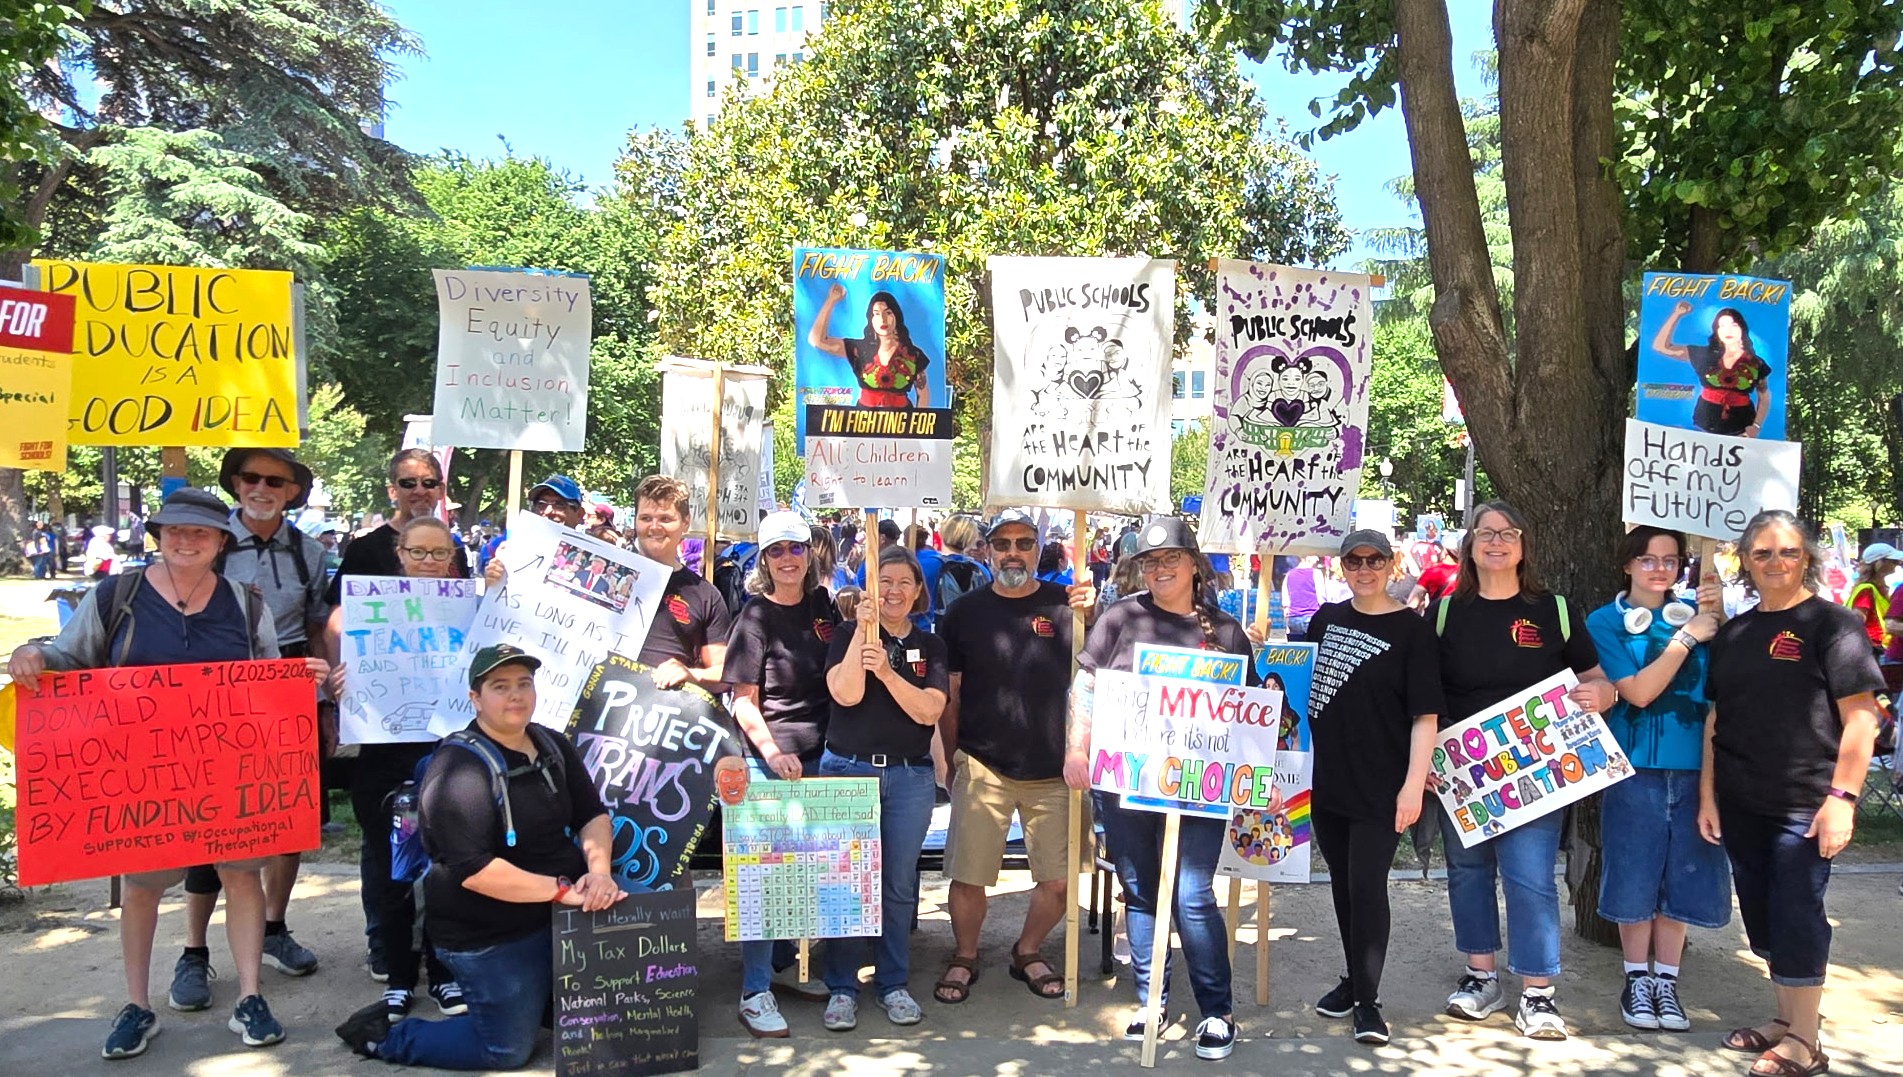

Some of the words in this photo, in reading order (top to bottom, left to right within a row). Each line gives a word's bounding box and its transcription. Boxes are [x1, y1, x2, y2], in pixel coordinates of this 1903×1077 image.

[798, 252, 869, 281] FIGHT
[871, 255, 939, 284] BACK!
[49, 264, 239, 318] PUBLIC
[445, 276, 579, 312] Diversity
[1019, 287, 1077, 322] PUBLIC
[1081, 283, 1150, 313] SCHOOLS
[1647, 276, 1717, 299] FIGHT
[1719, 280, 1786, 305] BACK!
[0, 301, 48, 338] FOR
[467, 307, 561, 349] Equity
[1230, 314, 1286, 349] PUBLIC
[1290, 310, 1357, 347] SCHOOLS
[492, 350, 534, 366] and
[141, 366, 168, 385] IS
[175, 366, 198, 385] A
[445, 365, 569, 394] Inclusion
[460, 397, 571, 425] Matter!
[821, 409, 845, 433] I'M
[846, 410, 907, 434] FIGHTING
[909, 412, 937, 435] FOR
[856, 441, 930, 464] Children
[1644, 427, 1744, 467] Hands
[811, 472, 844, 491] Right
[853, 472, 866, 483] to
[1023, 455, 1153, 493] COMMUNITY
[1687, 468, 1742, 502] my
[1220, 486, 1344, 517] COMMUNITY
[346, 580, 411, 596] DAMN
[484, 614, 523, 642] LIVE,
[495, 586, 522, 609] AS
[535, 602, 577, 629] LONG
[582, 622, 606, 641] AS
[609, 632, 628, 652] I
[358, 660, 399, 674] AND
[410, 654, 458, 671] THEIR
[609, 656, 647, 675] START
[1142, 652, 1190, 675] FIGHT
[1190, 657, 1239, 681] BACK!
[1267, 648, 1309, 666] BACK!
[108, 667, 183, 691] GOAL
[583, 663, 605, 699] GONNA
[27, 696, 157, 734] DONALD
[188, 688, 266, 718] WILL
[1159, 686, 1202, 718] MY
[1203, 687, 1276, 728] Voice
[594, 680, 730, 765] PROTECT
[1431, 684, 1569, 775] PROTECT
[27, 735, 130, 773] SHOW
[149, 714, 313, 759] IMPROVED
[1184, 724, 1202, 750] it's
[1208, 728, 1231, 753] not
[1470, 730, 1556, 789] PUBLIC
[28, 760, 216, 805] EXECUTIVE
[576, 732, 702, 822] TRANS
[789, 784, 800, 798] to
[804, 782, 828, 798] hurt
[833, 783, 868, 802] people!
[1092, 749, 1149, 791] MY
[1158, 756, 1273, 807] CHOICE
[1453, 738, 1609, 833] EDUCATION
[28, 812, 75, 845] BY
[87, 795, 222, 834] FUNDING
[726, 808, 738, 823] He
[746, 811, 756, 823] is
[759, 809, 788, 826] really
[831, 806, 851, 821] feel
[84, 832, 175, 855] SUPPORTED
[204, 832, 280, 855] Therapist
[671, 822, 705, 878] PROBLEM.
[727, 829, 734, 842] I
[738, 832, 755, 844] say
[797, 828, 820, 843] How
[822, 827, 846, 842] about
[557, 909, 579, 934] I
[592, 906, 652, 929] Literally
[561, 940, 587, 973] My
[592, 940, 626, 960] Tax
[638, 935, 688, 958] Dollars
[558, 974, 580, 991] To
[593, 970, 640, 991] Support
[561, 993, 606, 1011] National
[615, 991, 650, 1005] Parks,
[626, 1008, 661, 1020] Mental
[562, 1030, 583, 1040] and
